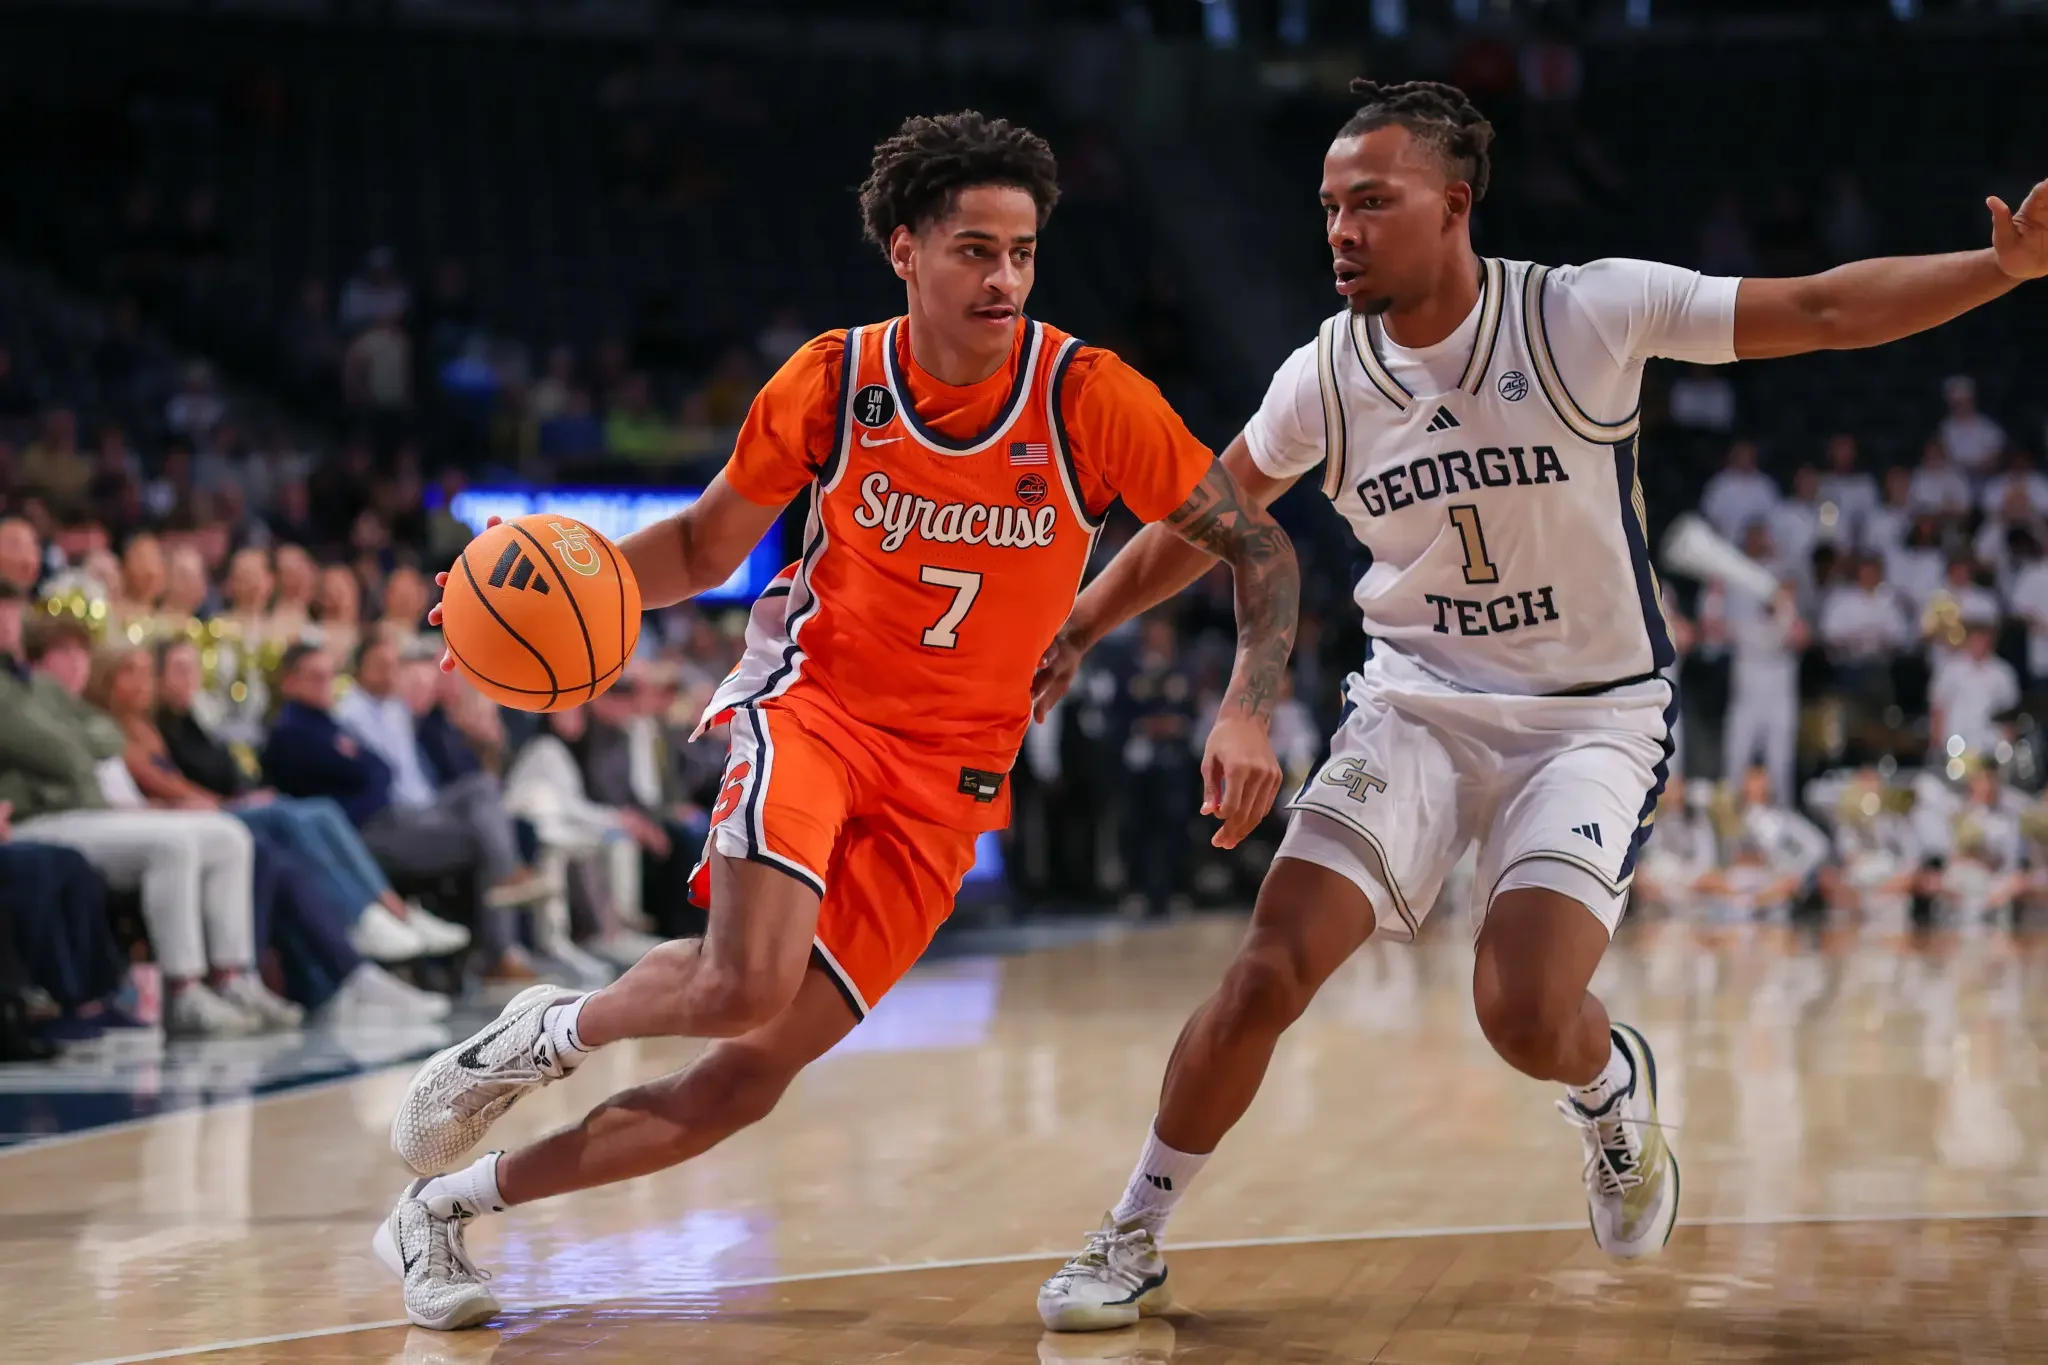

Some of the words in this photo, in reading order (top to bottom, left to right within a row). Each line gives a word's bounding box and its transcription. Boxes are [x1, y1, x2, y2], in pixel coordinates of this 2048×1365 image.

[865, 403, 882, 424] 21
[867, 389, 884, 404] LM
[853, 471, 1057, 552] Syracuse
[1356, 445, 1570, 518] GEORGIA
[1448, 504, 1499, 584] 1
[918, 564, 983, 649] 7
[1424, 585, 1559, 636] TECH
